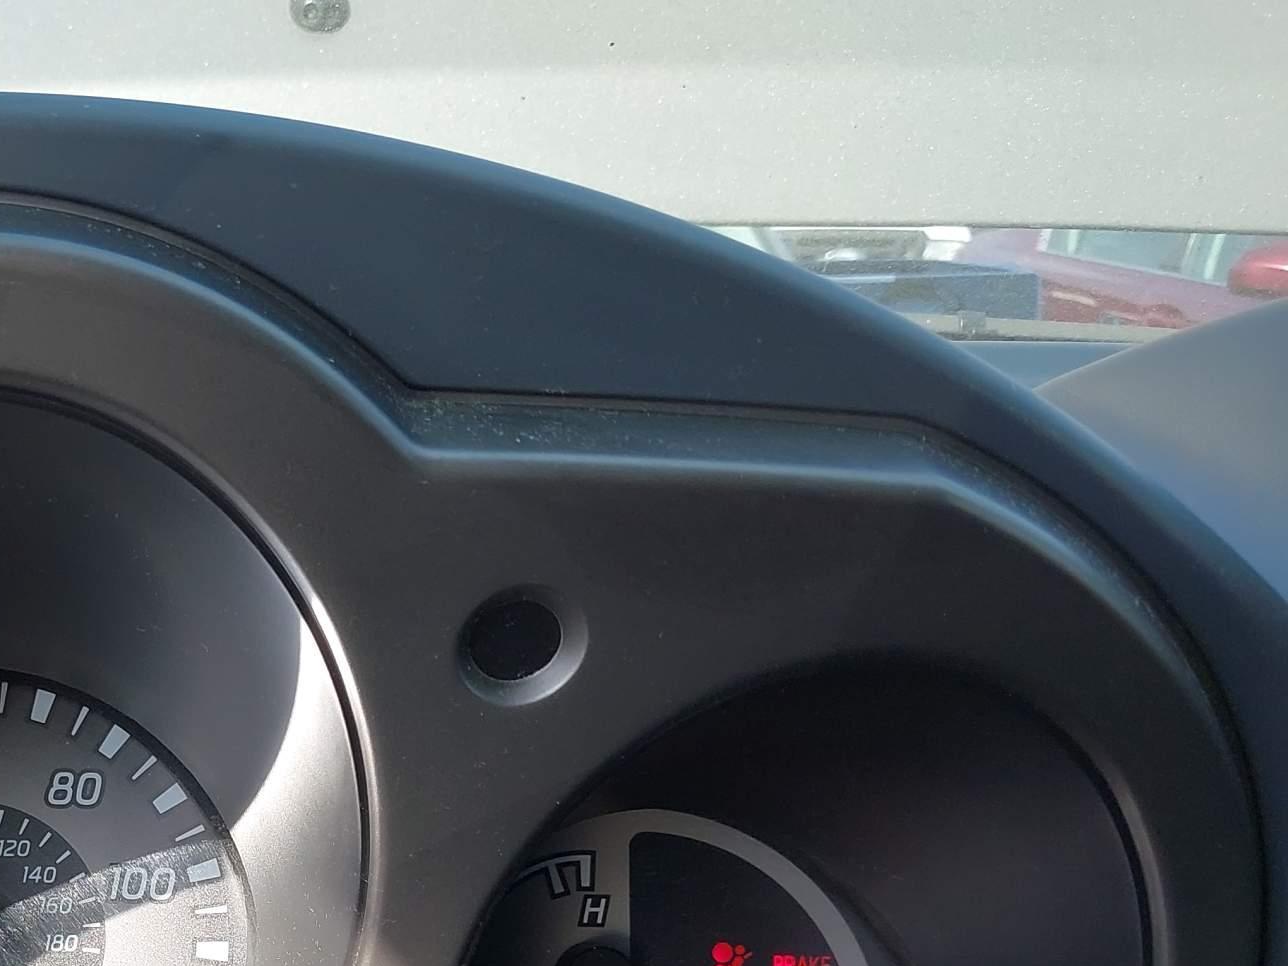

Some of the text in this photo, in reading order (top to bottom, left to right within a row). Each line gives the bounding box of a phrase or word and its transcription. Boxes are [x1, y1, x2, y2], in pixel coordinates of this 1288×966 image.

[48, 773, 103, 806] 80
[22, 865, 57, 885] 140
[110, 867, 176, 901] 100
[40, 895, 73, 915] 160
[582, 898, 607, 924] H
[45, 934, 79, 954] 180
